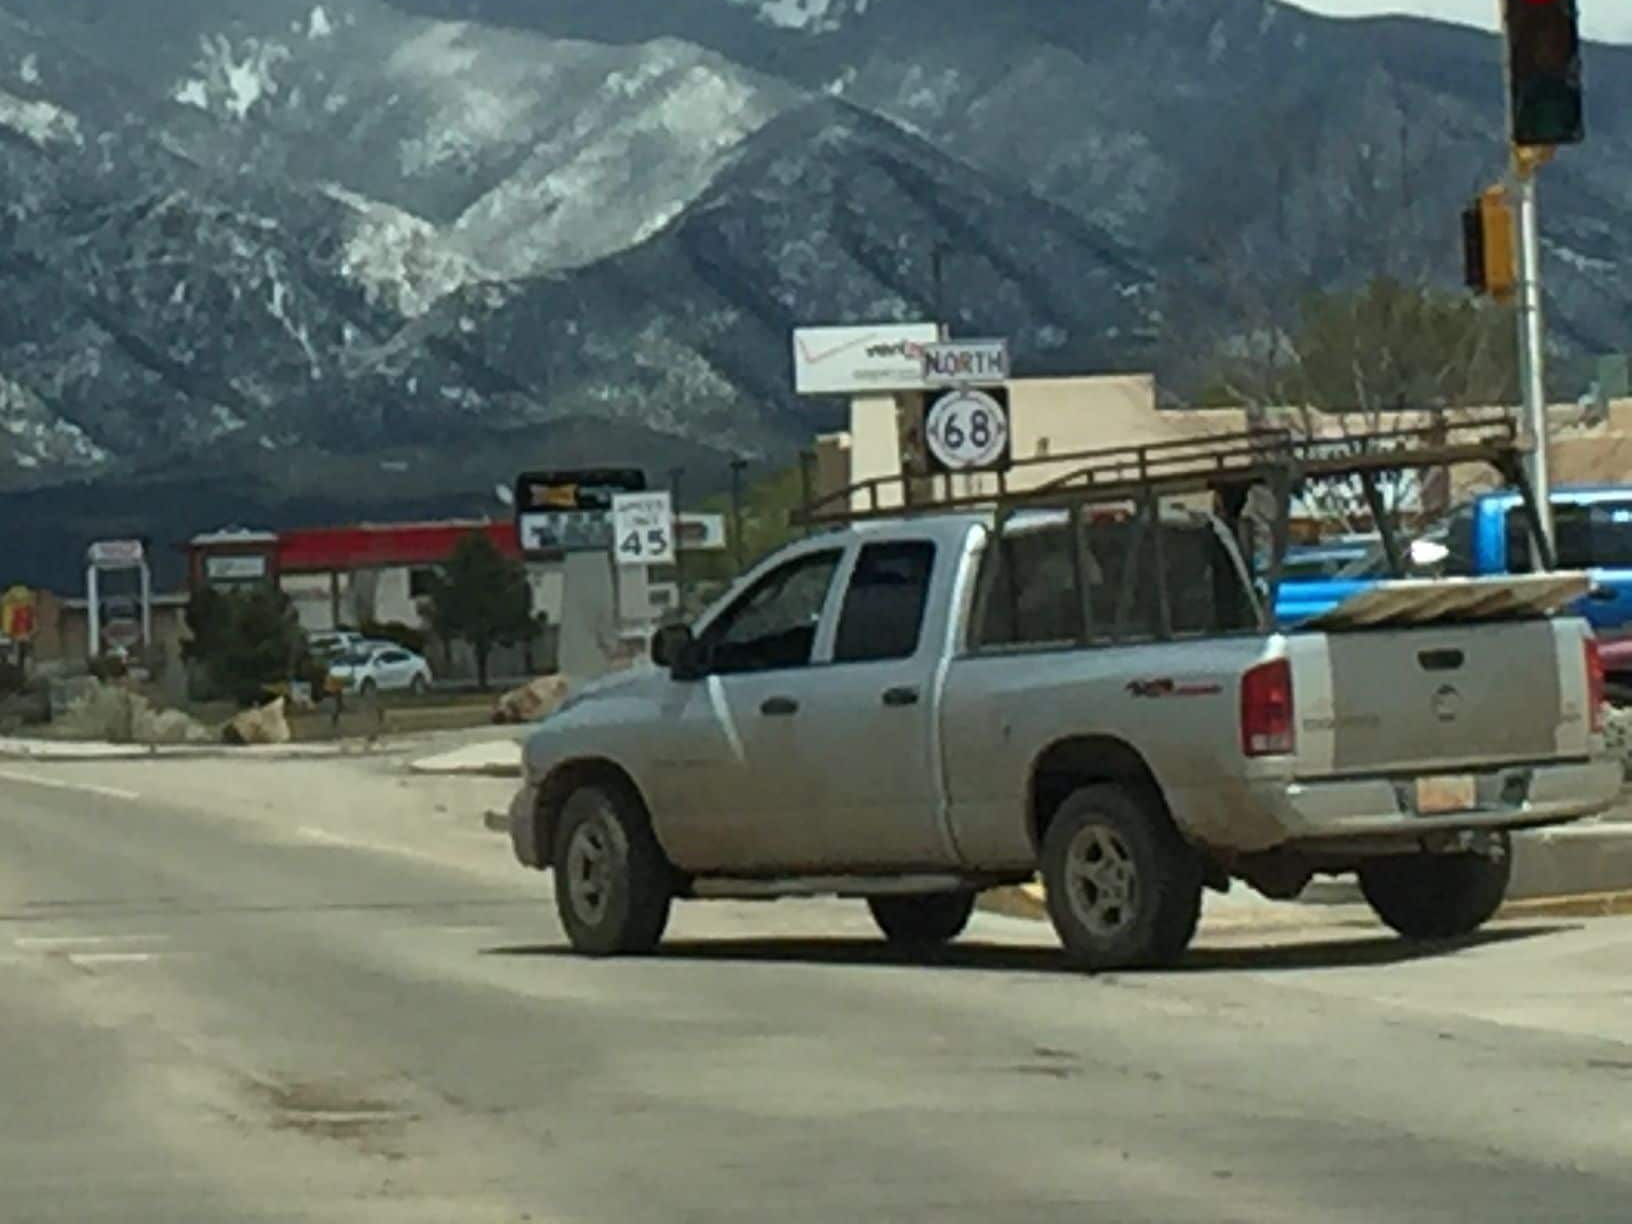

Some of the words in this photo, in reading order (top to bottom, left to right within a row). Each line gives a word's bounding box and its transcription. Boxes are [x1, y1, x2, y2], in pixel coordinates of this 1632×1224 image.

[924, 350, 1002, 376] NORTH
[943, 410, 990, 449] 68
[619, 528, 668, 556] 45
